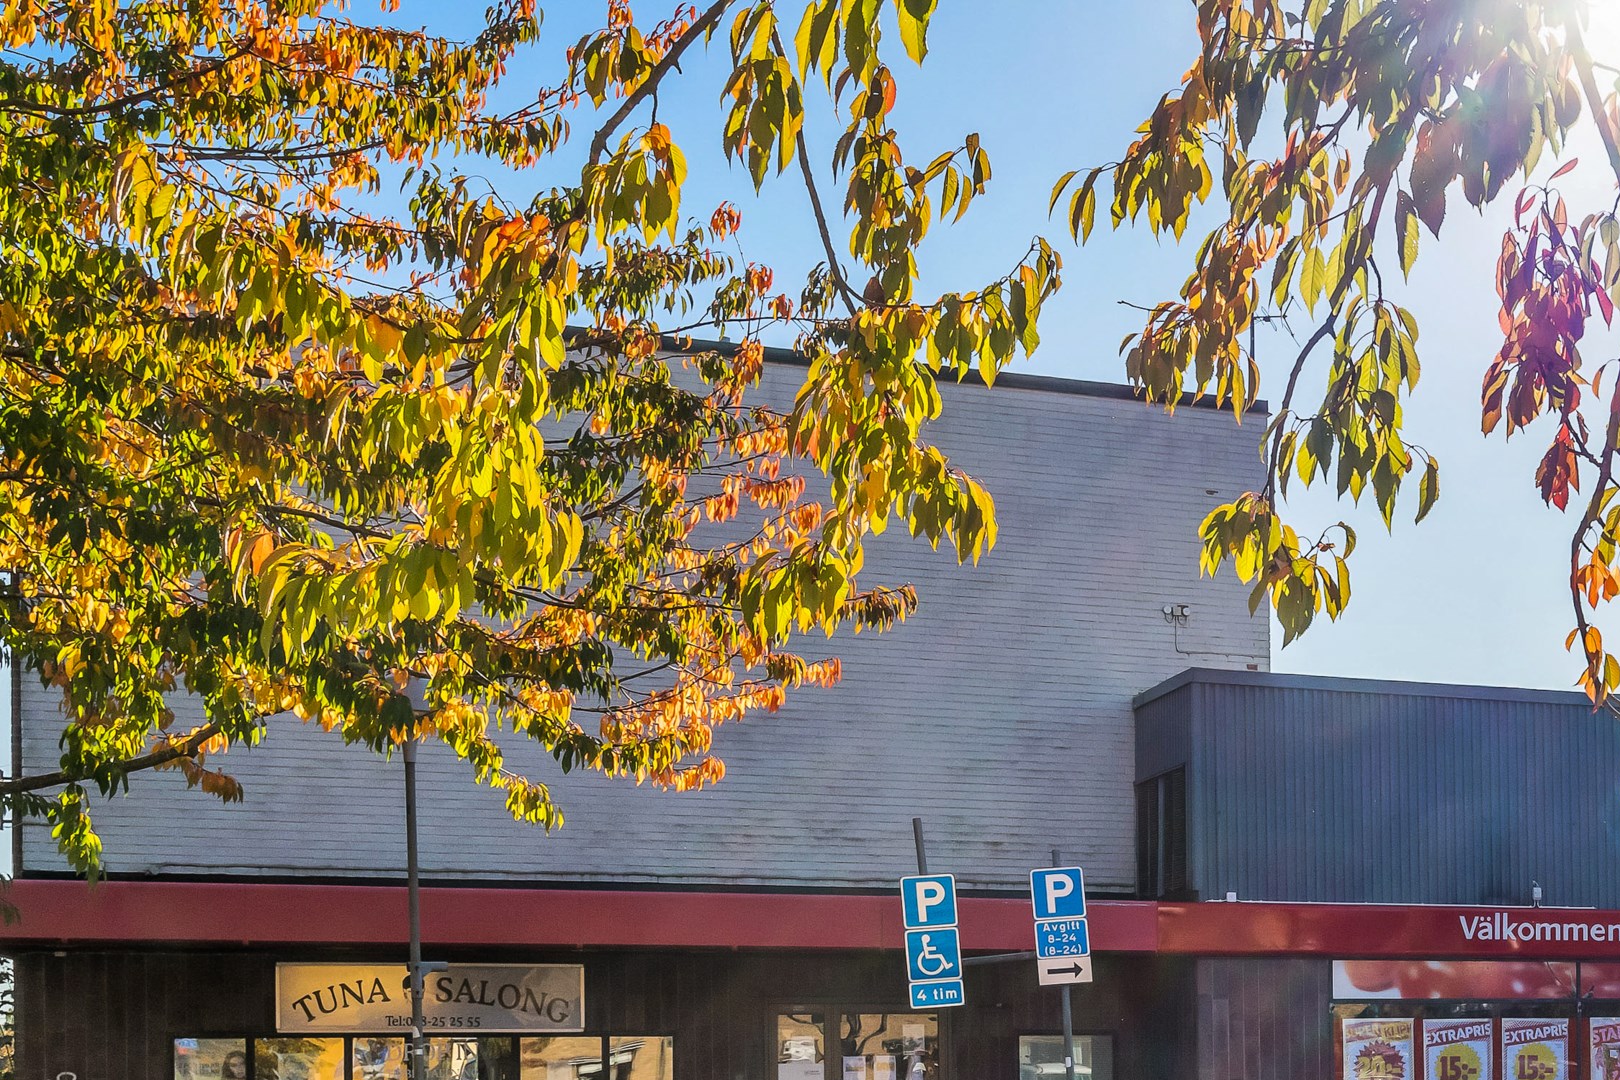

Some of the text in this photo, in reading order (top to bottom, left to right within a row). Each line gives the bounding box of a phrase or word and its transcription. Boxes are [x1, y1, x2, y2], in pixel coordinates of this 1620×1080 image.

[916, 881, 945, 922] P
[1045, 873, 1074, 914] P
[1043, 920, 1080, 933] Avgift
[1048, 933, 1077, 943] 8-24
[1044, 944, 1082, 957] (8-24)
[292, 976, 570, 1024] TUNA SALONG
[916, 987, 958, 1001] 4 tim
[1426, 1023, 1491, 1044] EXTRAPRIS
[1504, 1023, 1568, 1044] EXTRAPRIS
